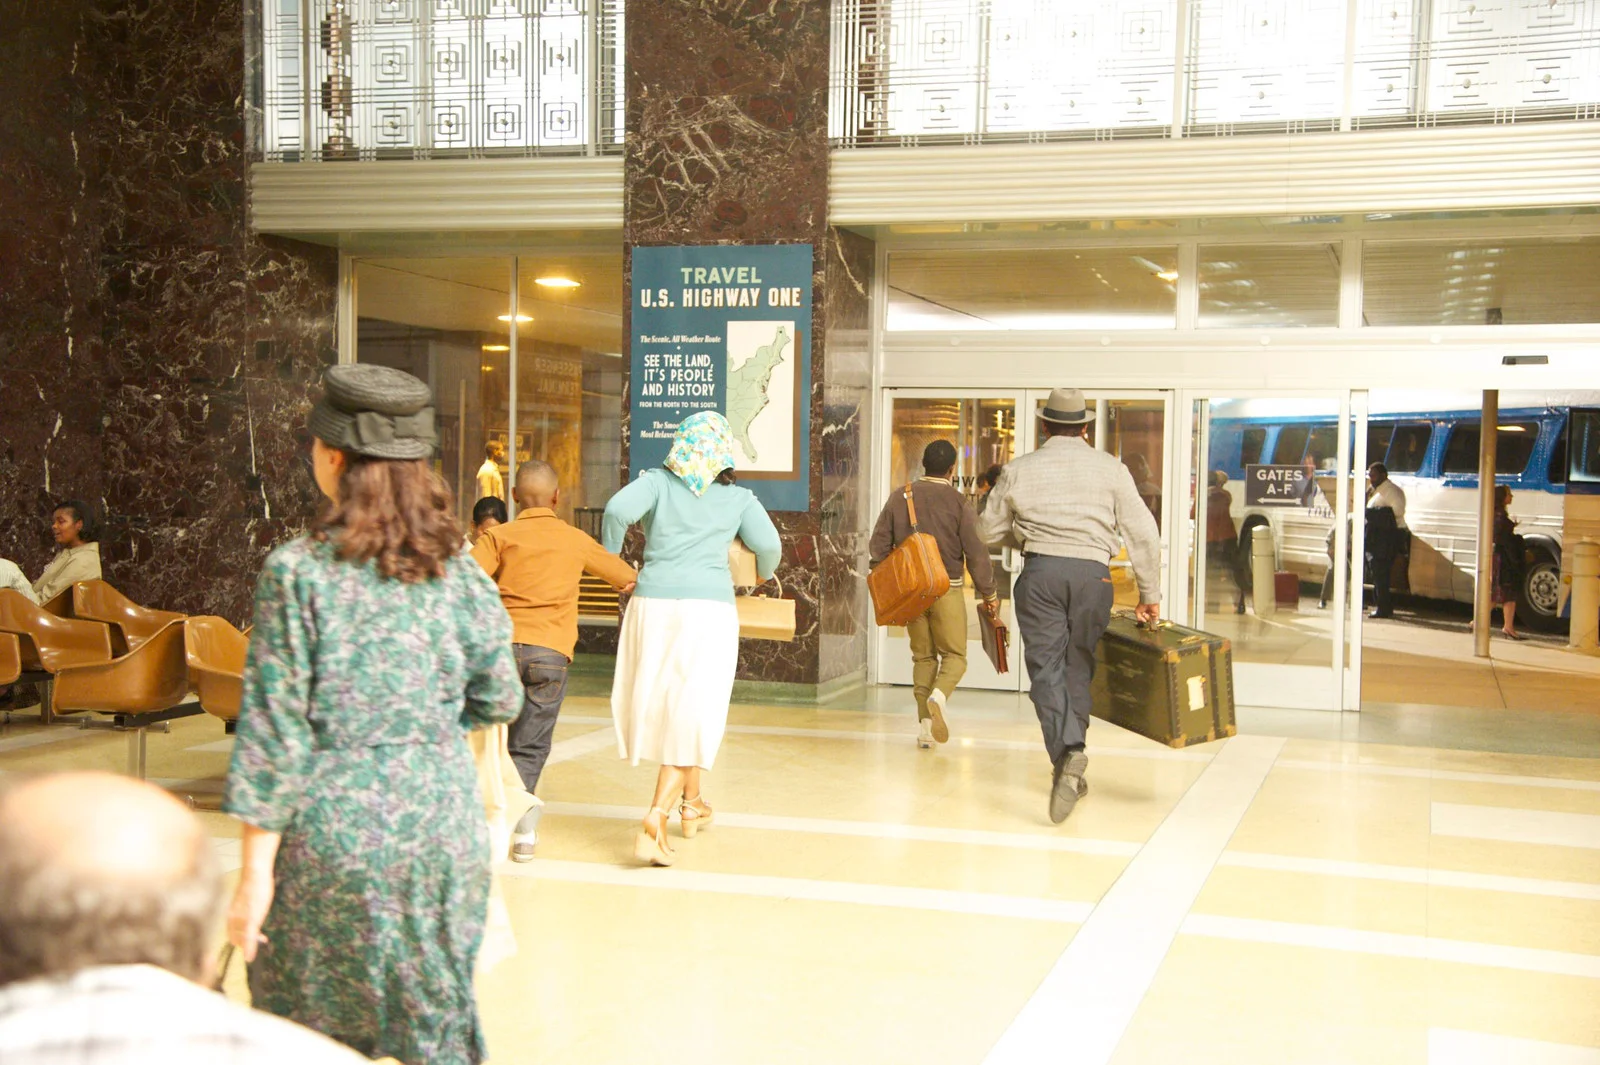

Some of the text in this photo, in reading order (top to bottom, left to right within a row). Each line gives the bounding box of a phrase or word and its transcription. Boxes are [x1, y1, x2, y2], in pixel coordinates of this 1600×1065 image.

[680, 267, 762, 284] TRAVEL
[640, 287, 802, 308] U.S. HIGHWAY ONE
[640, 335, 650, 343] The
[672, 335, 681, 343] All
[681, 335, 704, 343] Weather
[704, 335, 722, 343] Route
[644, 354, 714, 370] SEE THE LAND,
[644, 368, 714, 382] IT'S PEOPLE
[642, 383, 715, 396] AND HISTORY
[653, 421, 663, 429] The
[640, 430, 654, 438] Most
[1256, 470, 1304, 481] GATES
[1266, 484, 1292, 495] A-F
